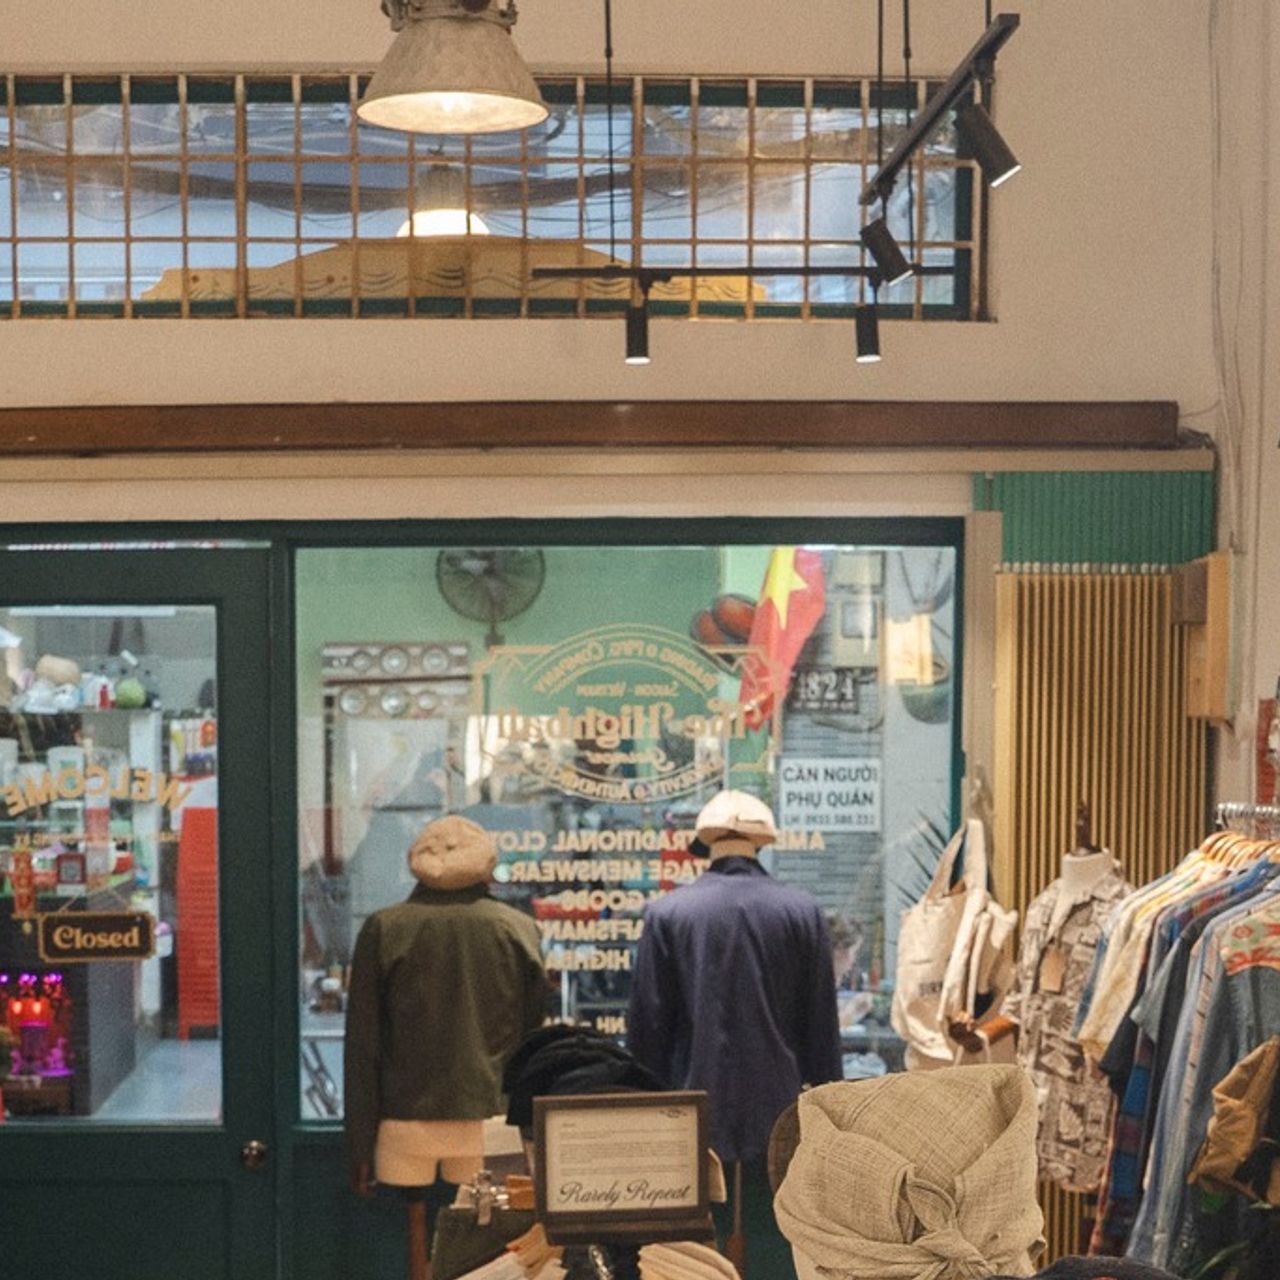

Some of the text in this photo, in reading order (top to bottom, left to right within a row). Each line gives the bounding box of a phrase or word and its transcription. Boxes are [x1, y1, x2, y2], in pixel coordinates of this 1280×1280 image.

[53, 925, 141, 950] Closed
[559, 1178, 691, 1210] Rarely Repeat
